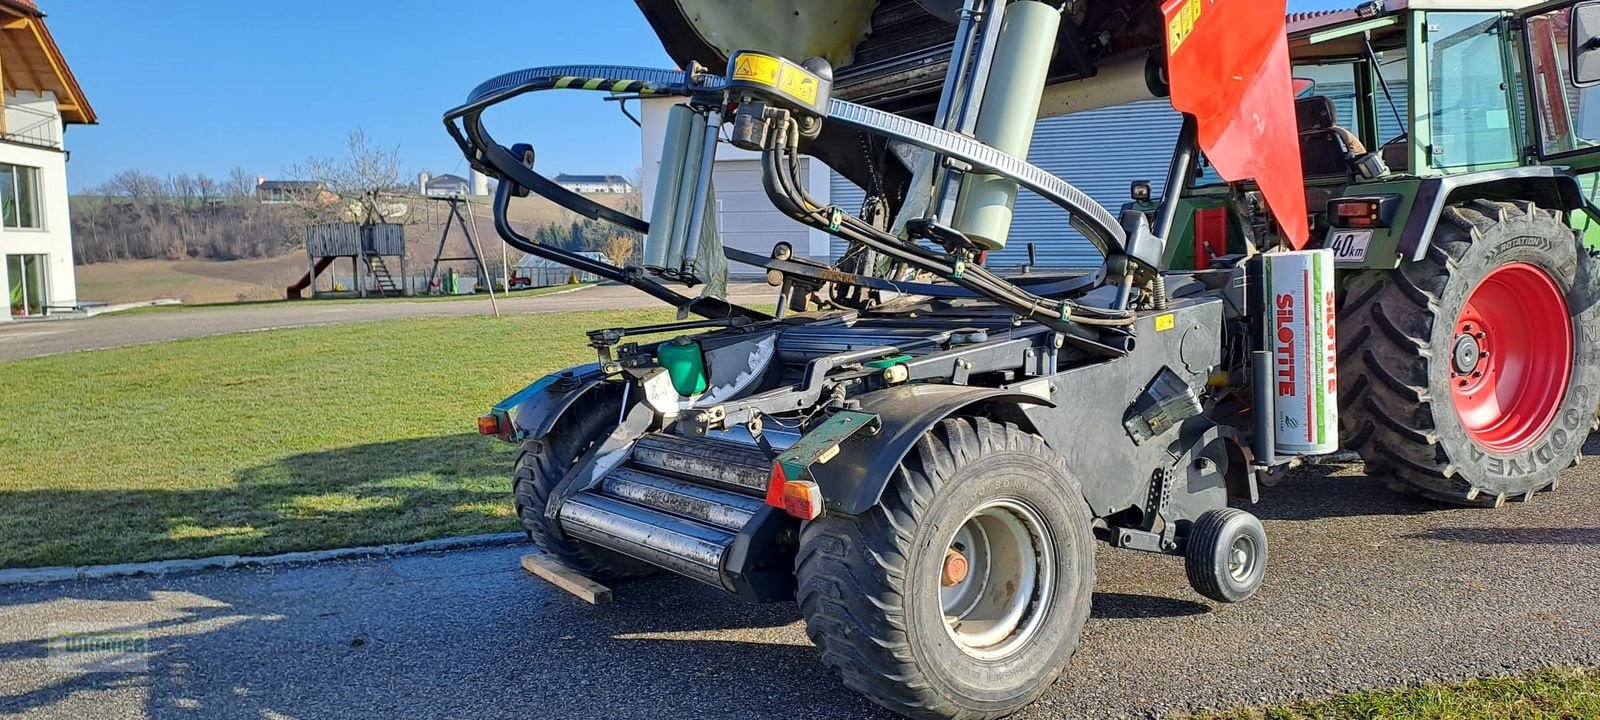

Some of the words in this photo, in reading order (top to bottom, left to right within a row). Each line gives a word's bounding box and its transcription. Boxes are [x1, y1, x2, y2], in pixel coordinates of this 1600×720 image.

[1331, 234, 1354, 257] 40
[1349, 246, 1364, 257] km
[1500, 236, 1541, 251] ROTATION
[1452, 384, 1589, 477] GOODYEAR
